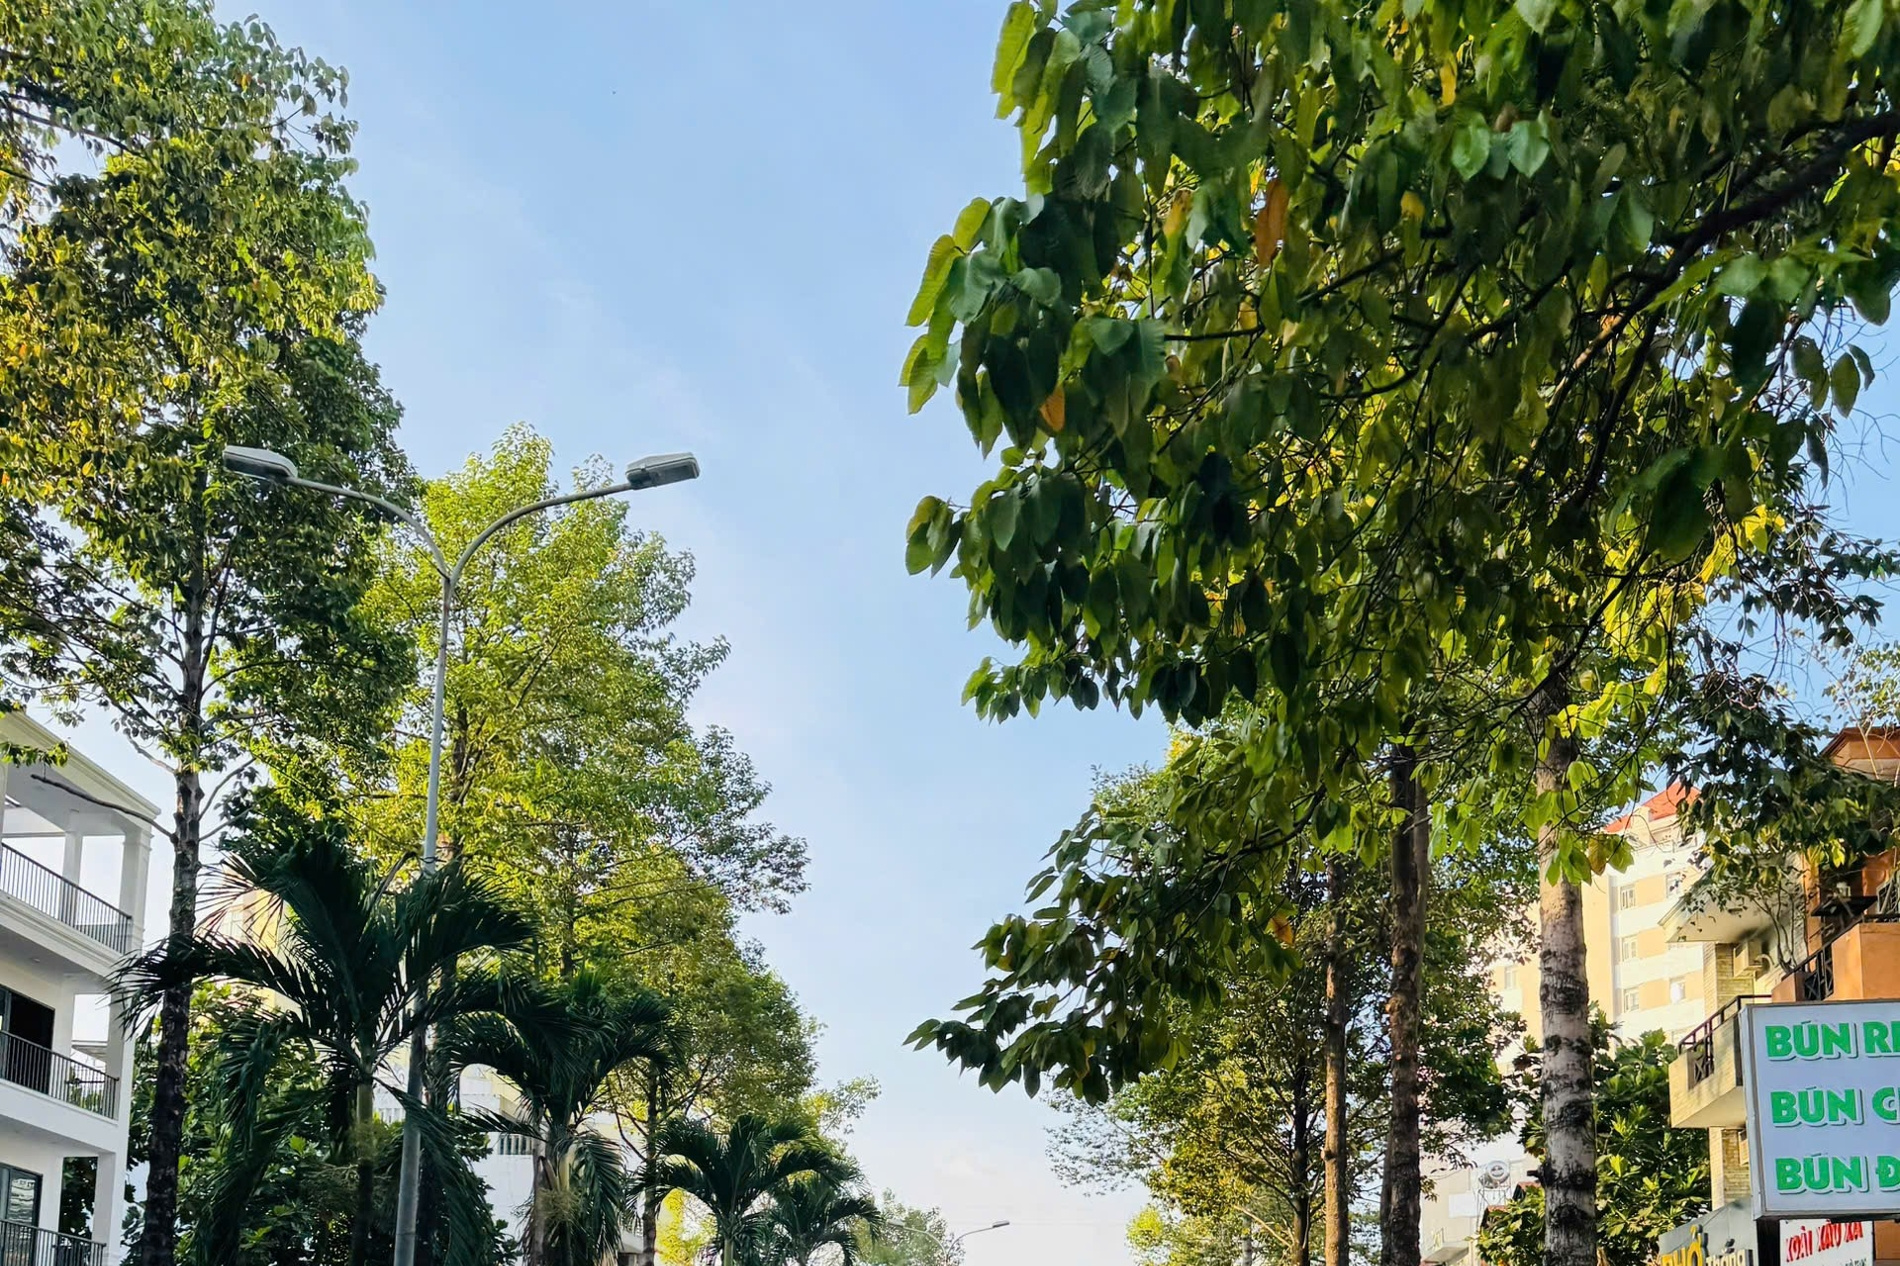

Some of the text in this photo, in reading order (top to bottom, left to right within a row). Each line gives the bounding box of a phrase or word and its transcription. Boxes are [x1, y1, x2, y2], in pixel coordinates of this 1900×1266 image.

[1765, 1020, 1852, 1058] BÚN
[1770, 1086, 1857, 1125] BÚN
[1775, 1152, 1862, 1191] BÚN
